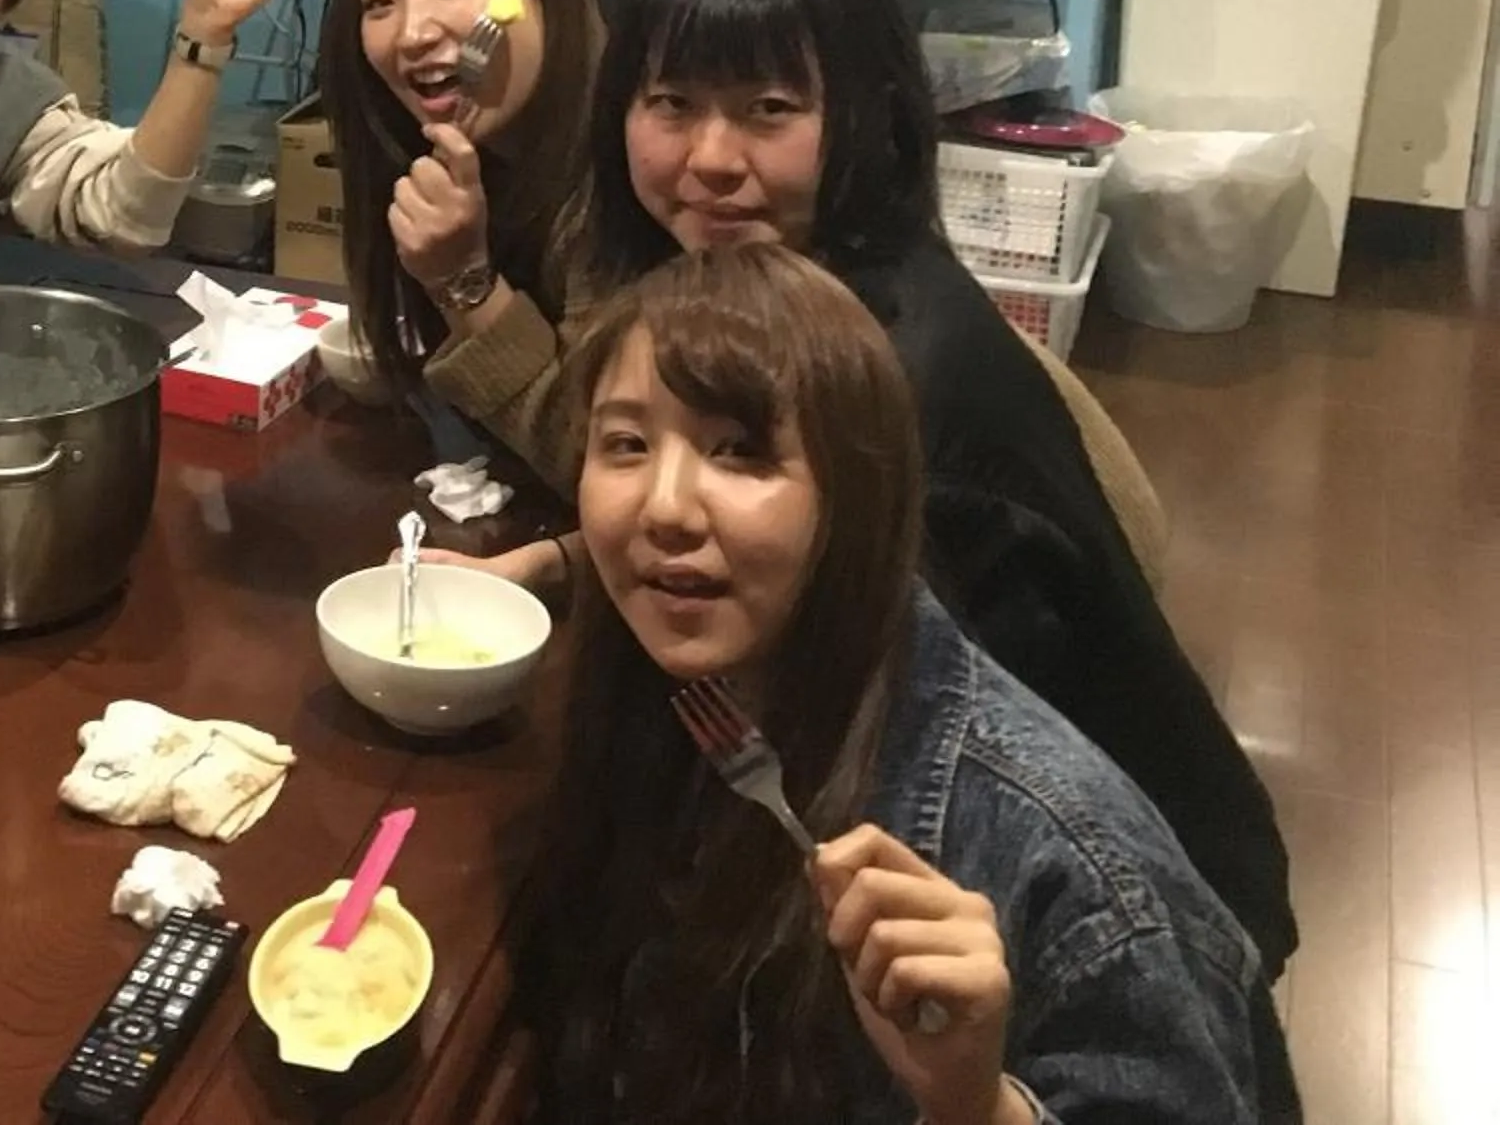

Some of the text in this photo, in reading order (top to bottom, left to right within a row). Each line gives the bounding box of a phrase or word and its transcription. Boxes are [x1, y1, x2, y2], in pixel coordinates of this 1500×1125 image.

[159, 933, 171, 945] 1
[179, 939, 196, 951] 2
[131, 970, 150, 983] 10
[154, 976, 173, 990] 11
